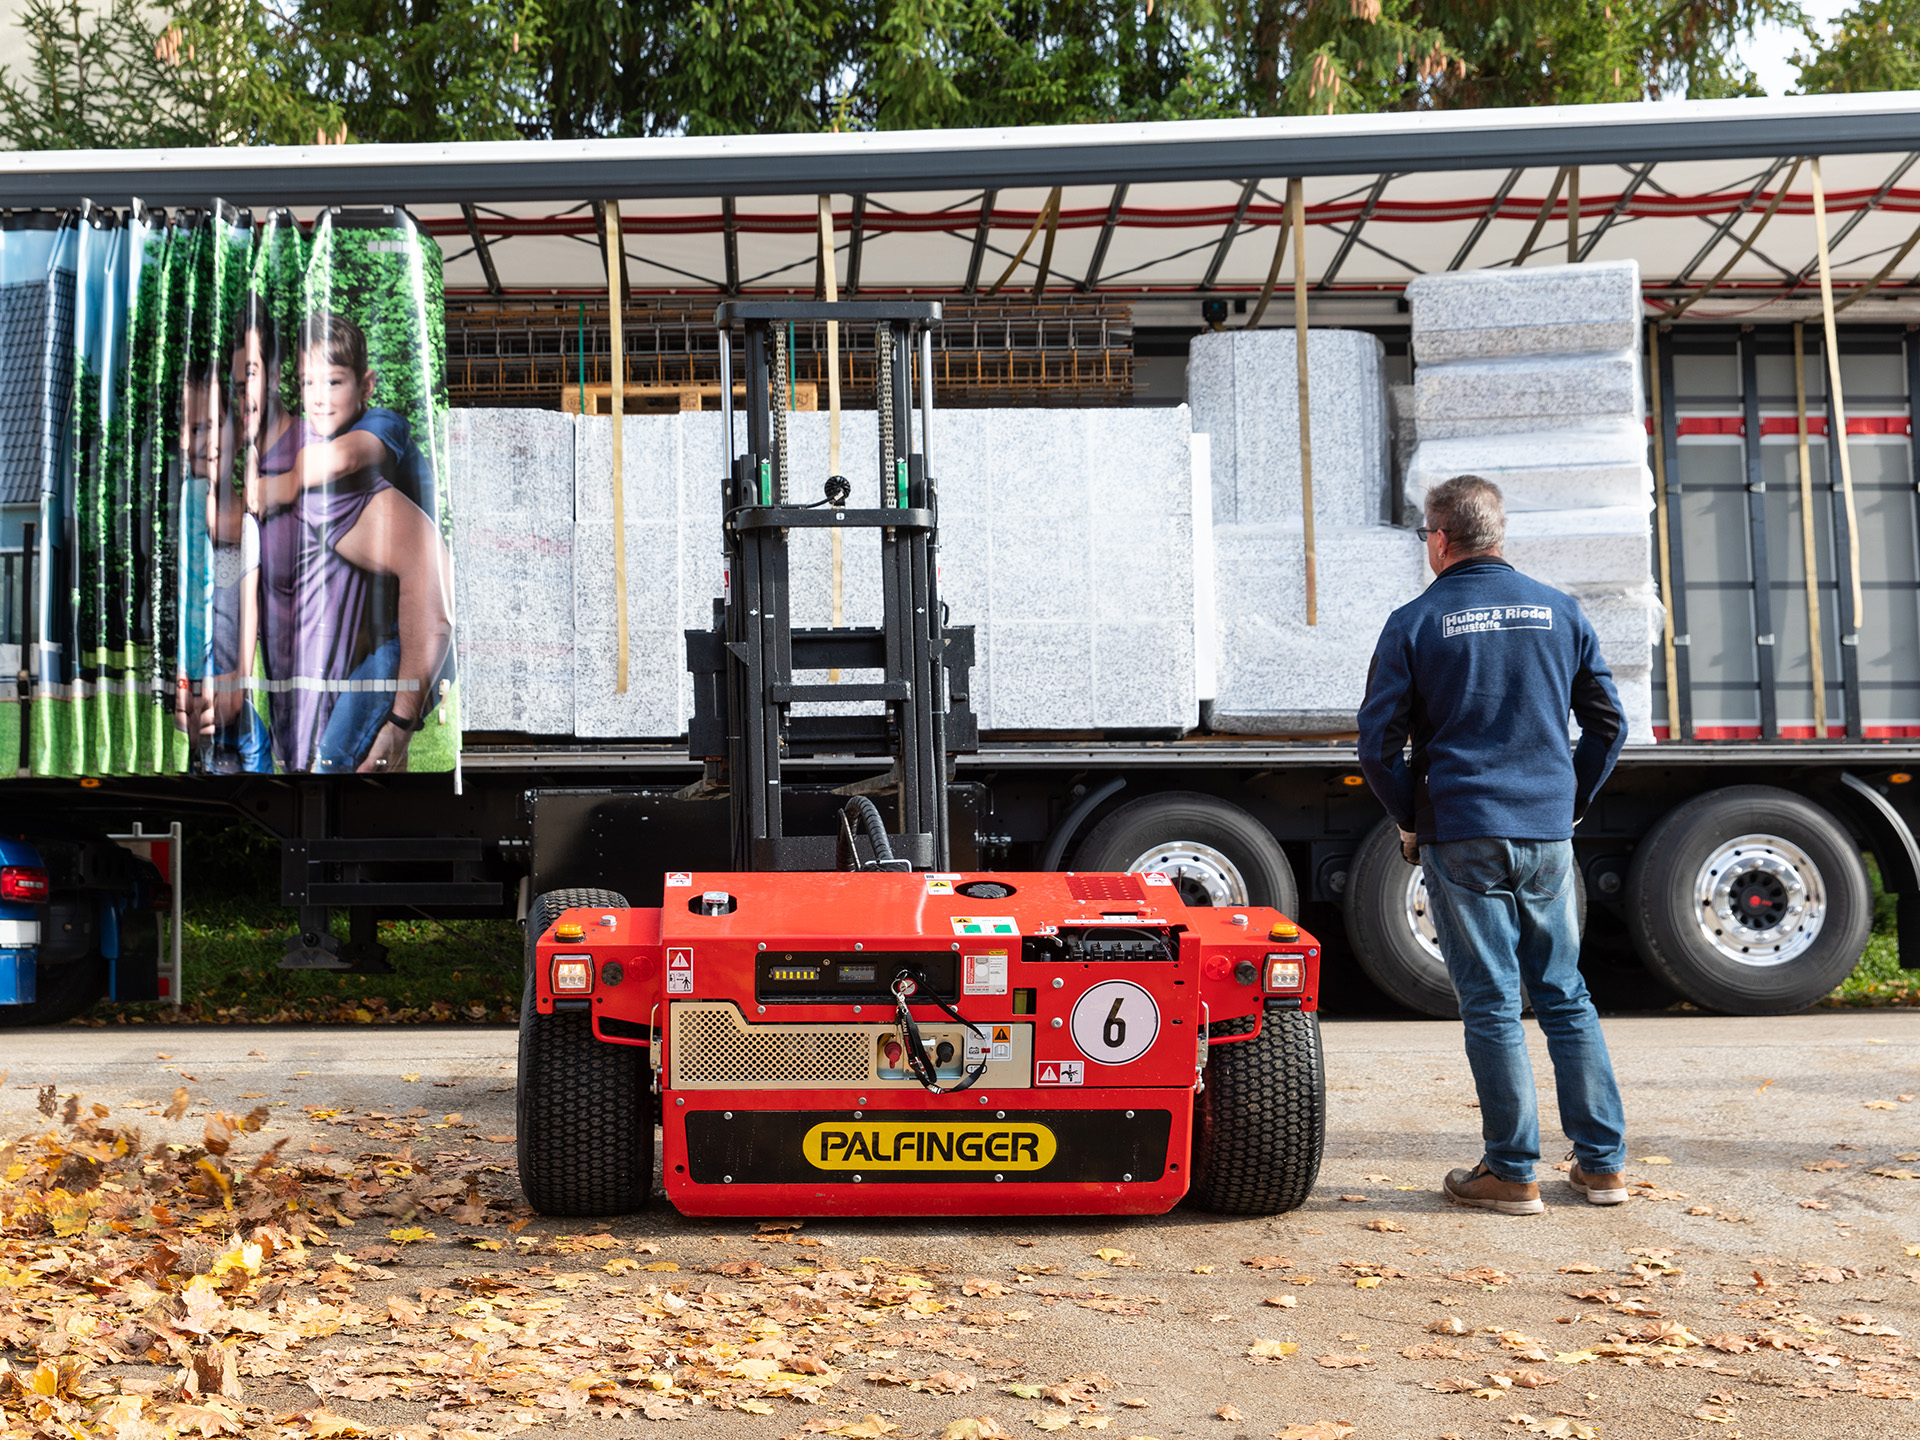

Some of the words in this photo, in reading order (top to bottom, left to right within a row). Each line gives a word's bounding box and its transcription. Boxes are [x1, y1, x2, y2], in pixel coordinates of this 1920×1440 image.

[1446, 612, 1490, 627] Huber
[1491, 609, 1503, 620] &
[1505, 608, 1550, 620] Riedel
[1446, 620, 1501, 635] Baustoffe
[1103, 998, 1125, 1048] 6
[820, 1131, 1039, 1162] PALFINGER
